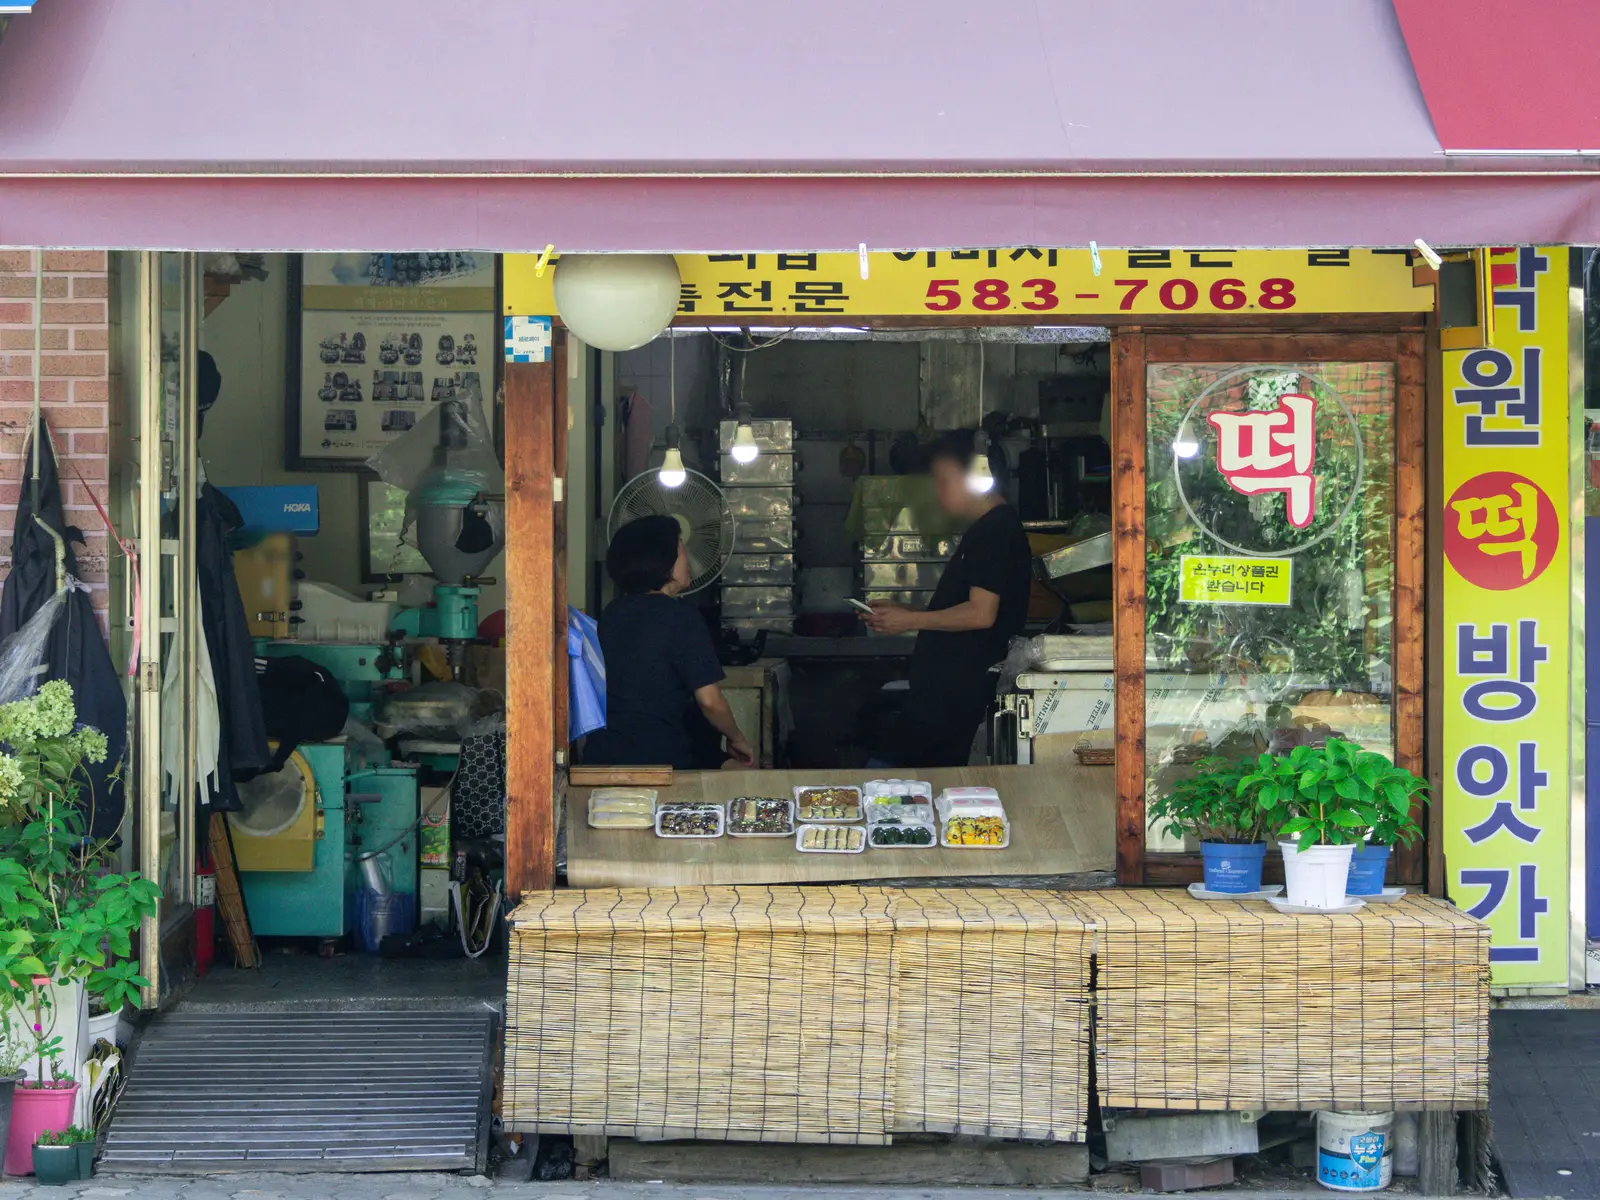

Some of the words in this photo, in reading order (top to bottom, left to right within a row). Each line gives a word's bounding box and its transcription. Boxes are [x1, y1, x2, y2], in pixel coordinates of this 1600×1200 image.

[924, 278, 1297, 311] 583-7068
[1207, 393, 1318, 529] 떡
[283, 503, 312, 513] HOKA
[1450, 482, 1538, 580] 떡
[1193, 562, 1235, 577] 온누리
[1237, 564, 1279, 578] 상품권
[1206, 580, 1265, 594] 받습니다
[1456, 620, 1549, 963] 방앗간
